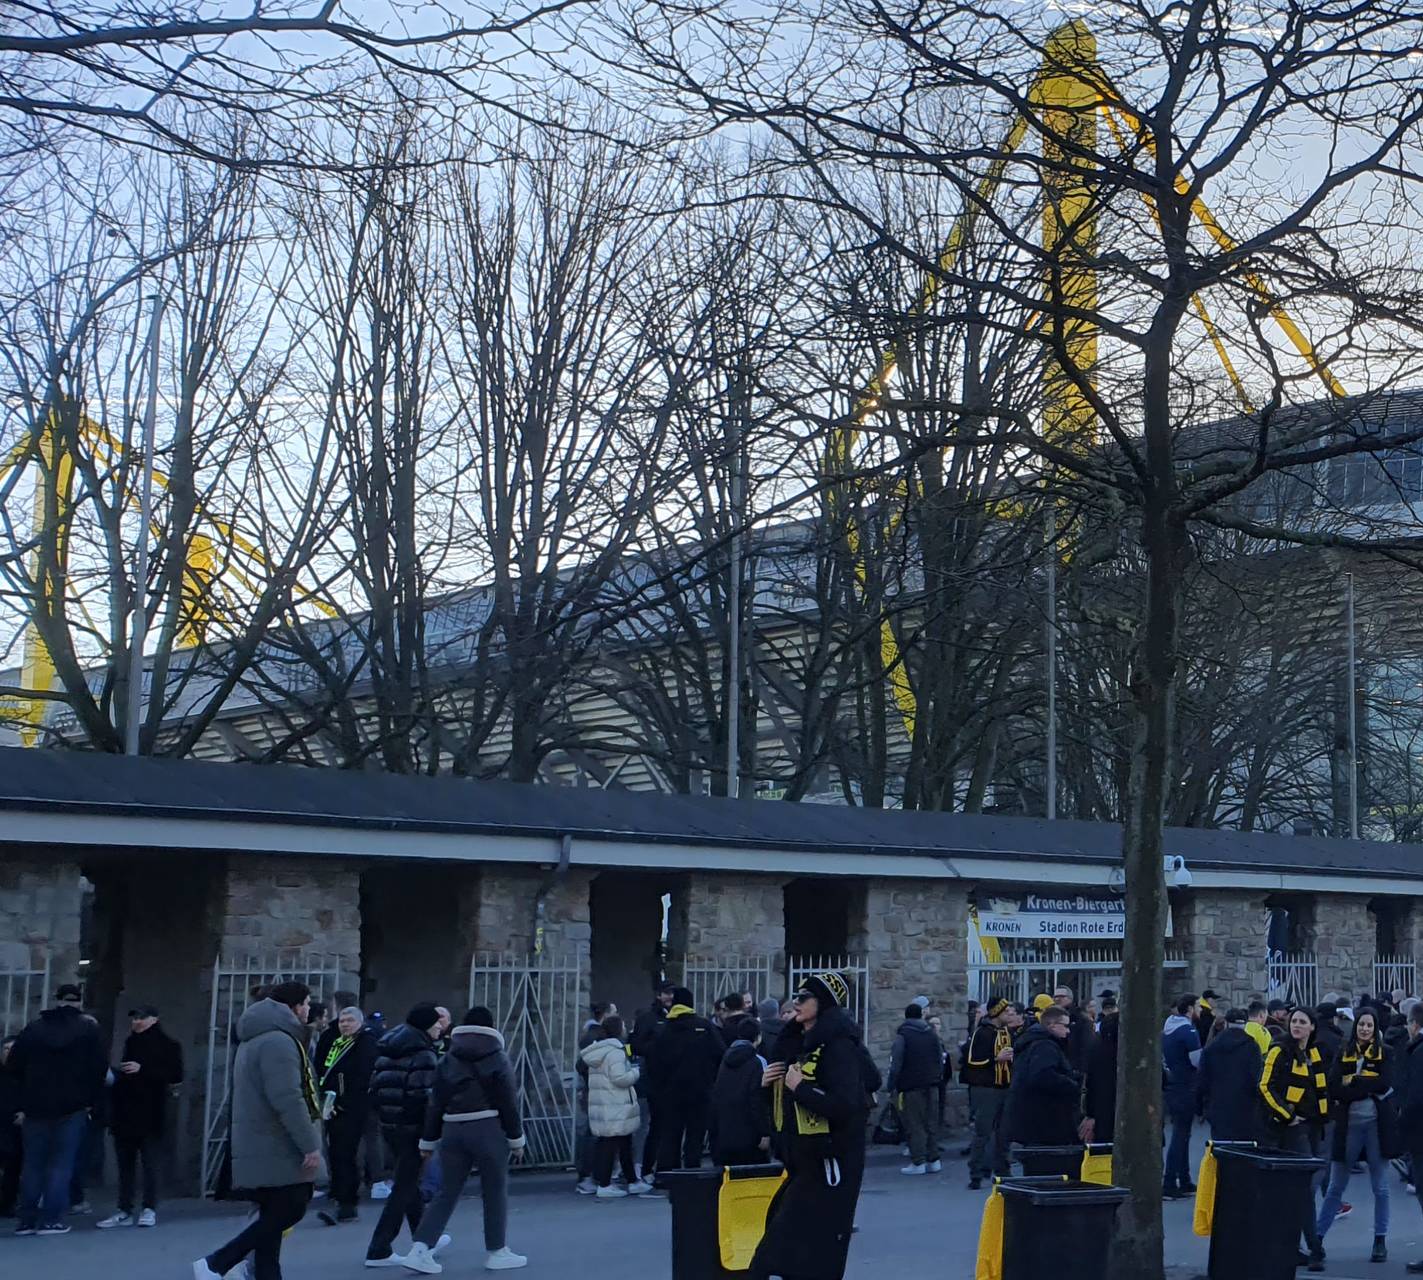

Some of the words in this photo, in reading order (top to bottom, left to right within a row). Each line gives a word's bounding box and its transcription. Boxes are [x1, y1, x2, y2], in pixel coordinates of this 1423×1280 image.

[1027, 895, 1125, 913] Kronen-Biergart
[986, 921, 1021, 932] KRONEN
[1040, 921, 1078, 933] Stadion
[1081, 922, 1104, 933] Rote
[1107, 922, 1124, 933] Erd
